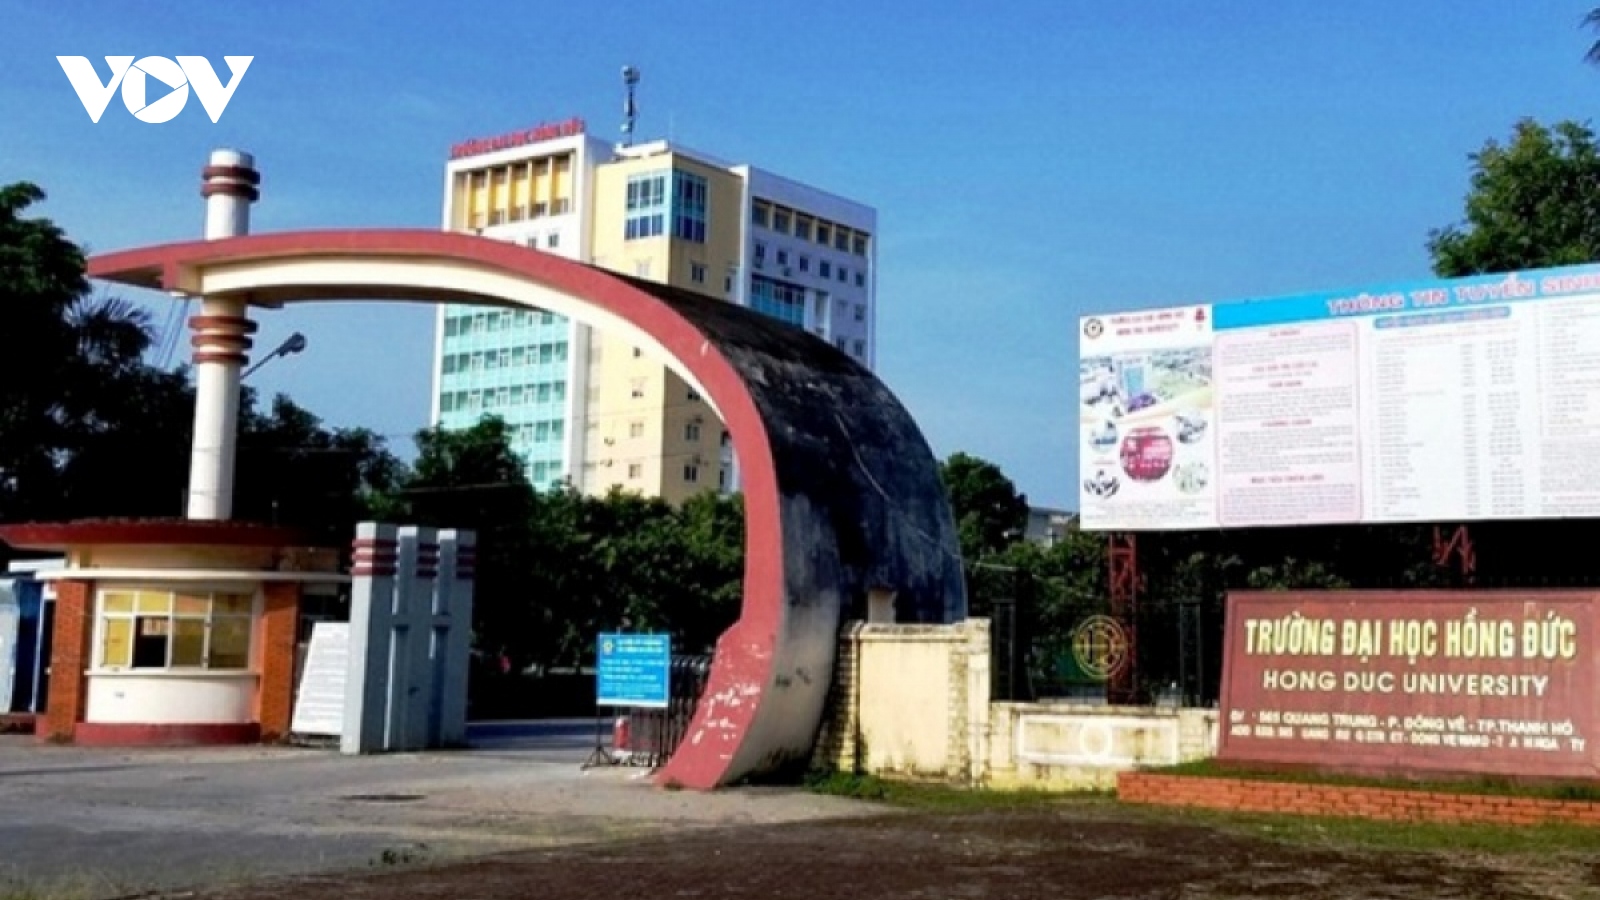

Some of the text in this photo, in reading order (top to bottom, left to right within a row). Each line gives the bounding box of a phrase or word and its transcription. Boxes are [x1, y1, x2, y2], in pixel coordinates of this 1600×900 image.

[1327, 293, 1404, 316] THÔNG
[1411, 288, 1449, 307] TIN
[1454, 273, 1533, 301] TUYỂN
[1244, 606, 1577, 665] TRƯỜNG ĐẠI HỌC HỒNG ĐỨC
[1263, 670, 1549, 697] HONG DUC UNIVERSITY
